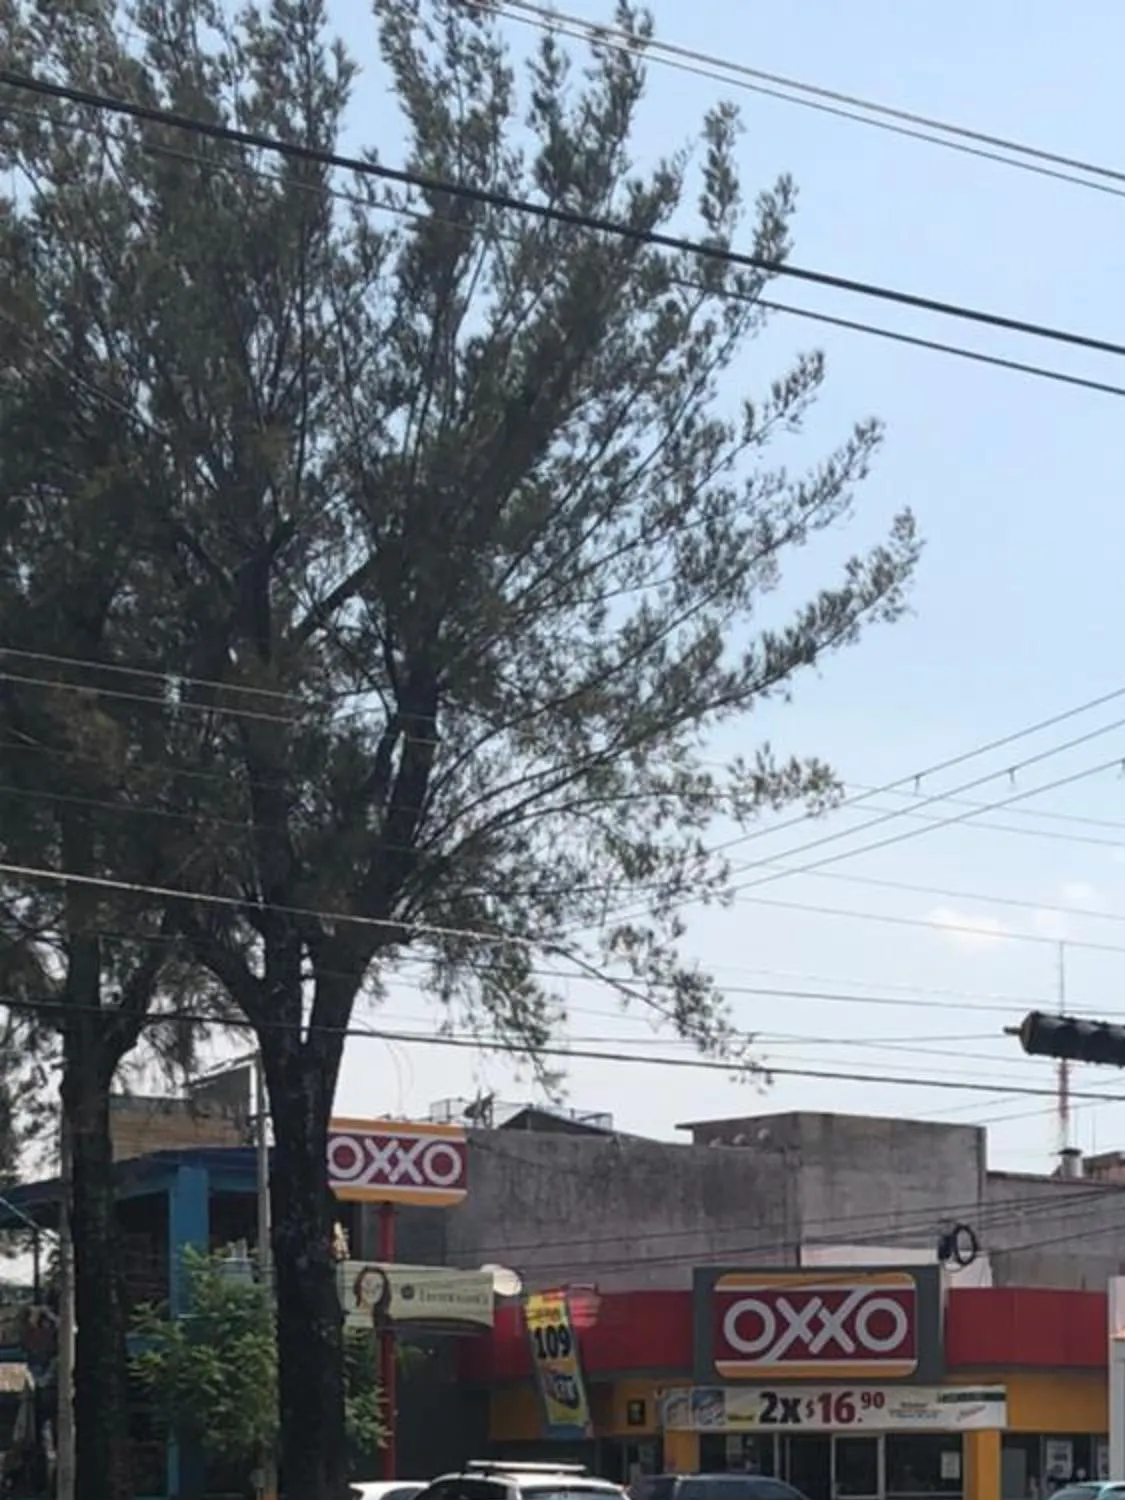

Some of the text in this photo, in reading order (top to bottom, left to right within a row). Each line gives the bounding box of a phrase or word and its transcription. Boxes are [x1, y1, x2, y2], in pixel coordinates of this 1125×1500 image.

[327, 1136, 463, 1186] OXXO
[532, 1324, 572, 1359] 109
[723, 1290, 909, 1361] OXXO
